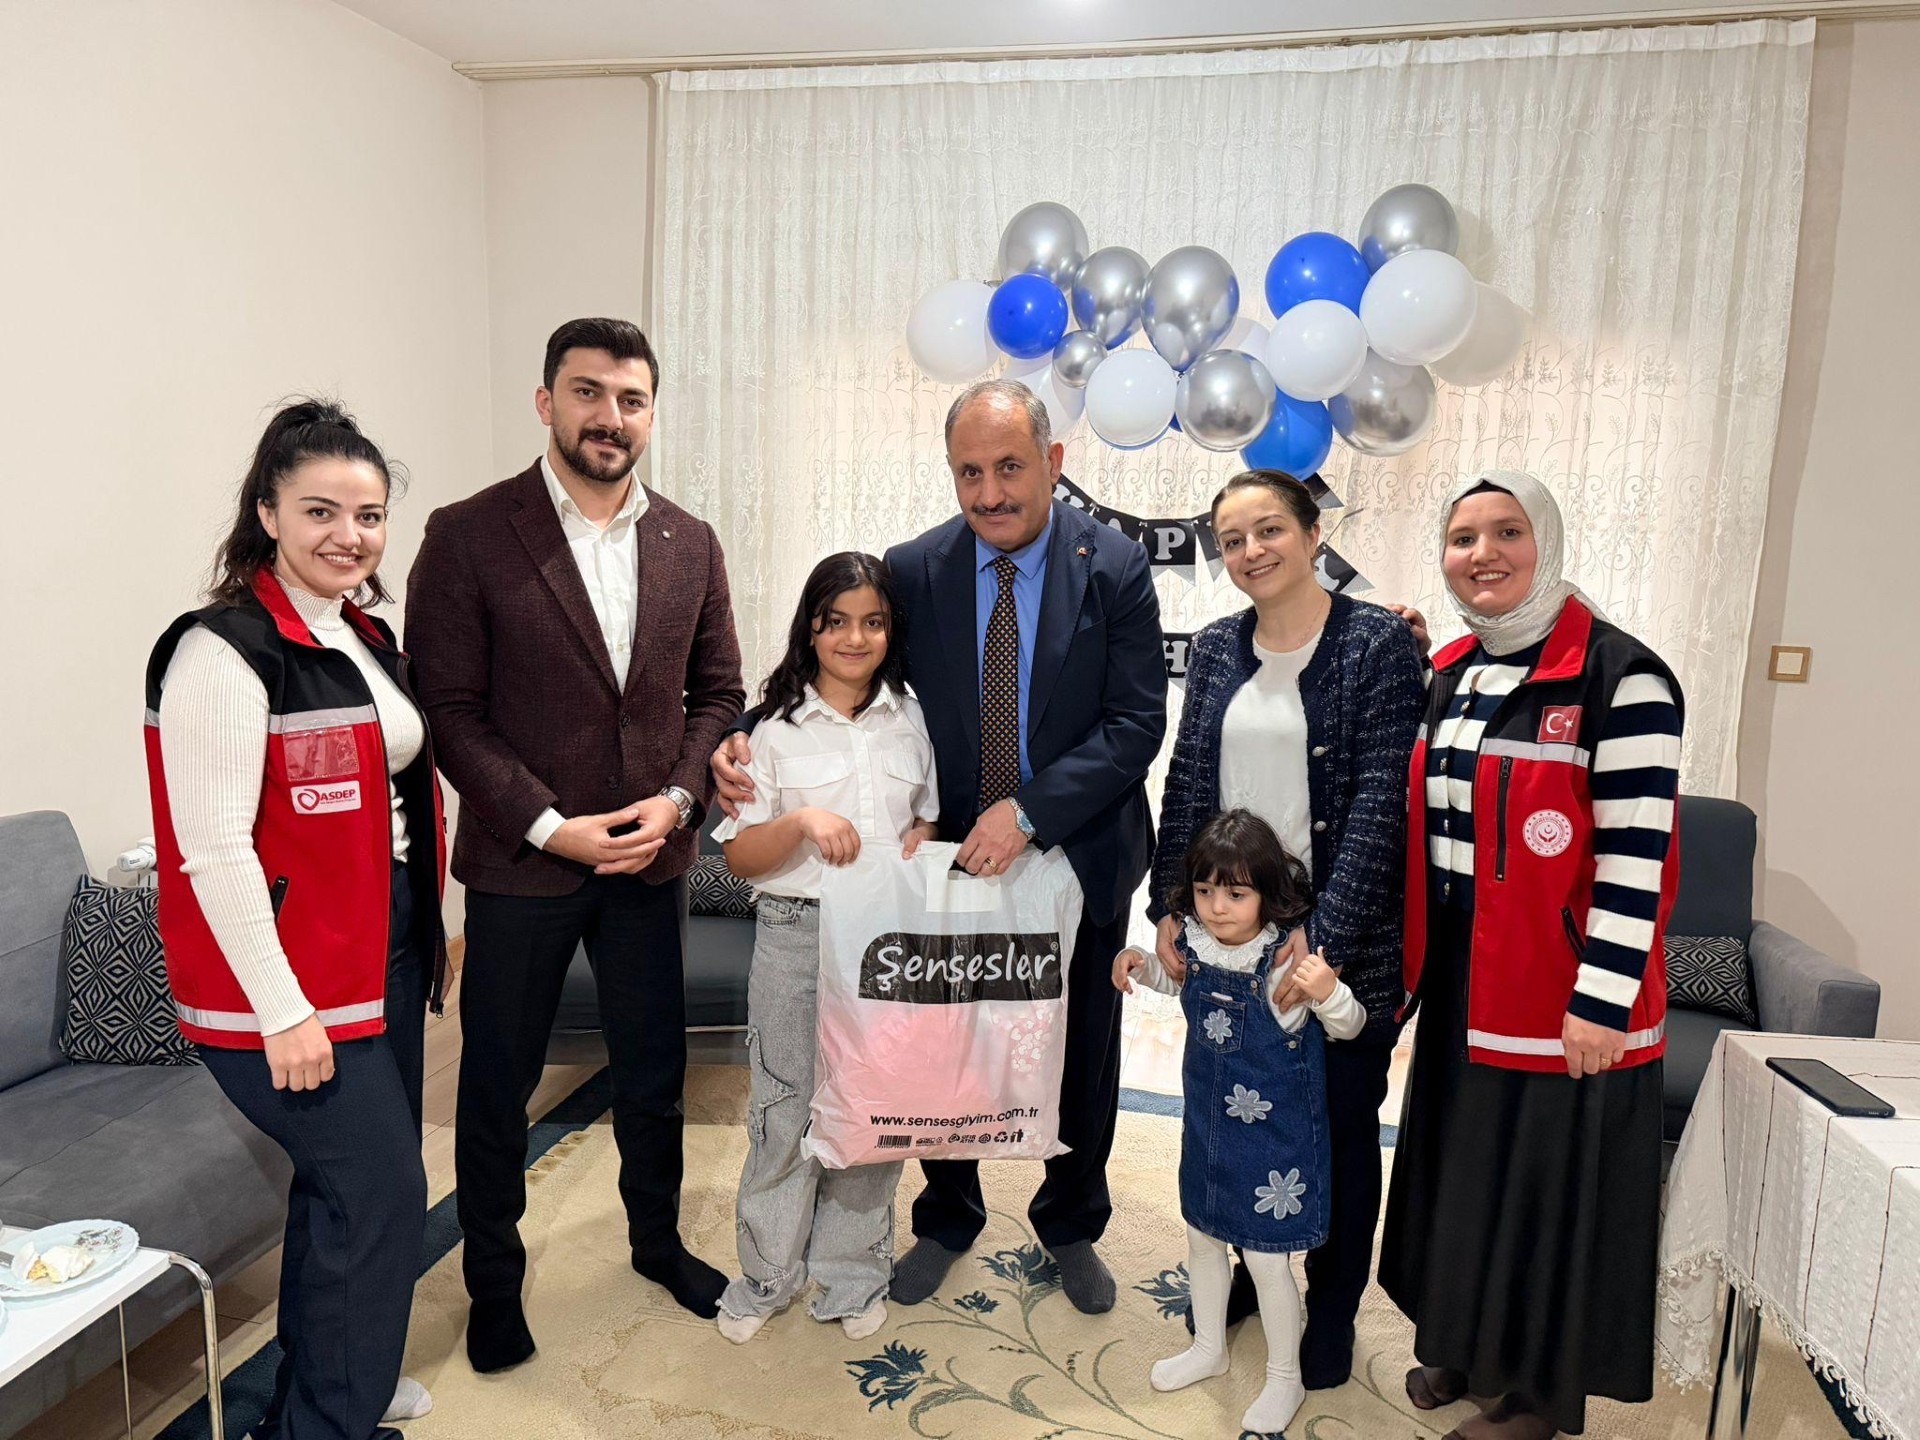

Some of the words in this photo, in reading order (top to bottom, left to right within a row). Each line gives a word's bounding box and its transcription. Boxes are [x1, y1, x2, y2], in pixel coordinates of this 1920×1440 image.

[320, 789, 356, 801] ASDEP
[876, 942, 1056, 992] Şensesler
[870, 1106, 1039, 1129] www.sensesgiyim.com.tr
